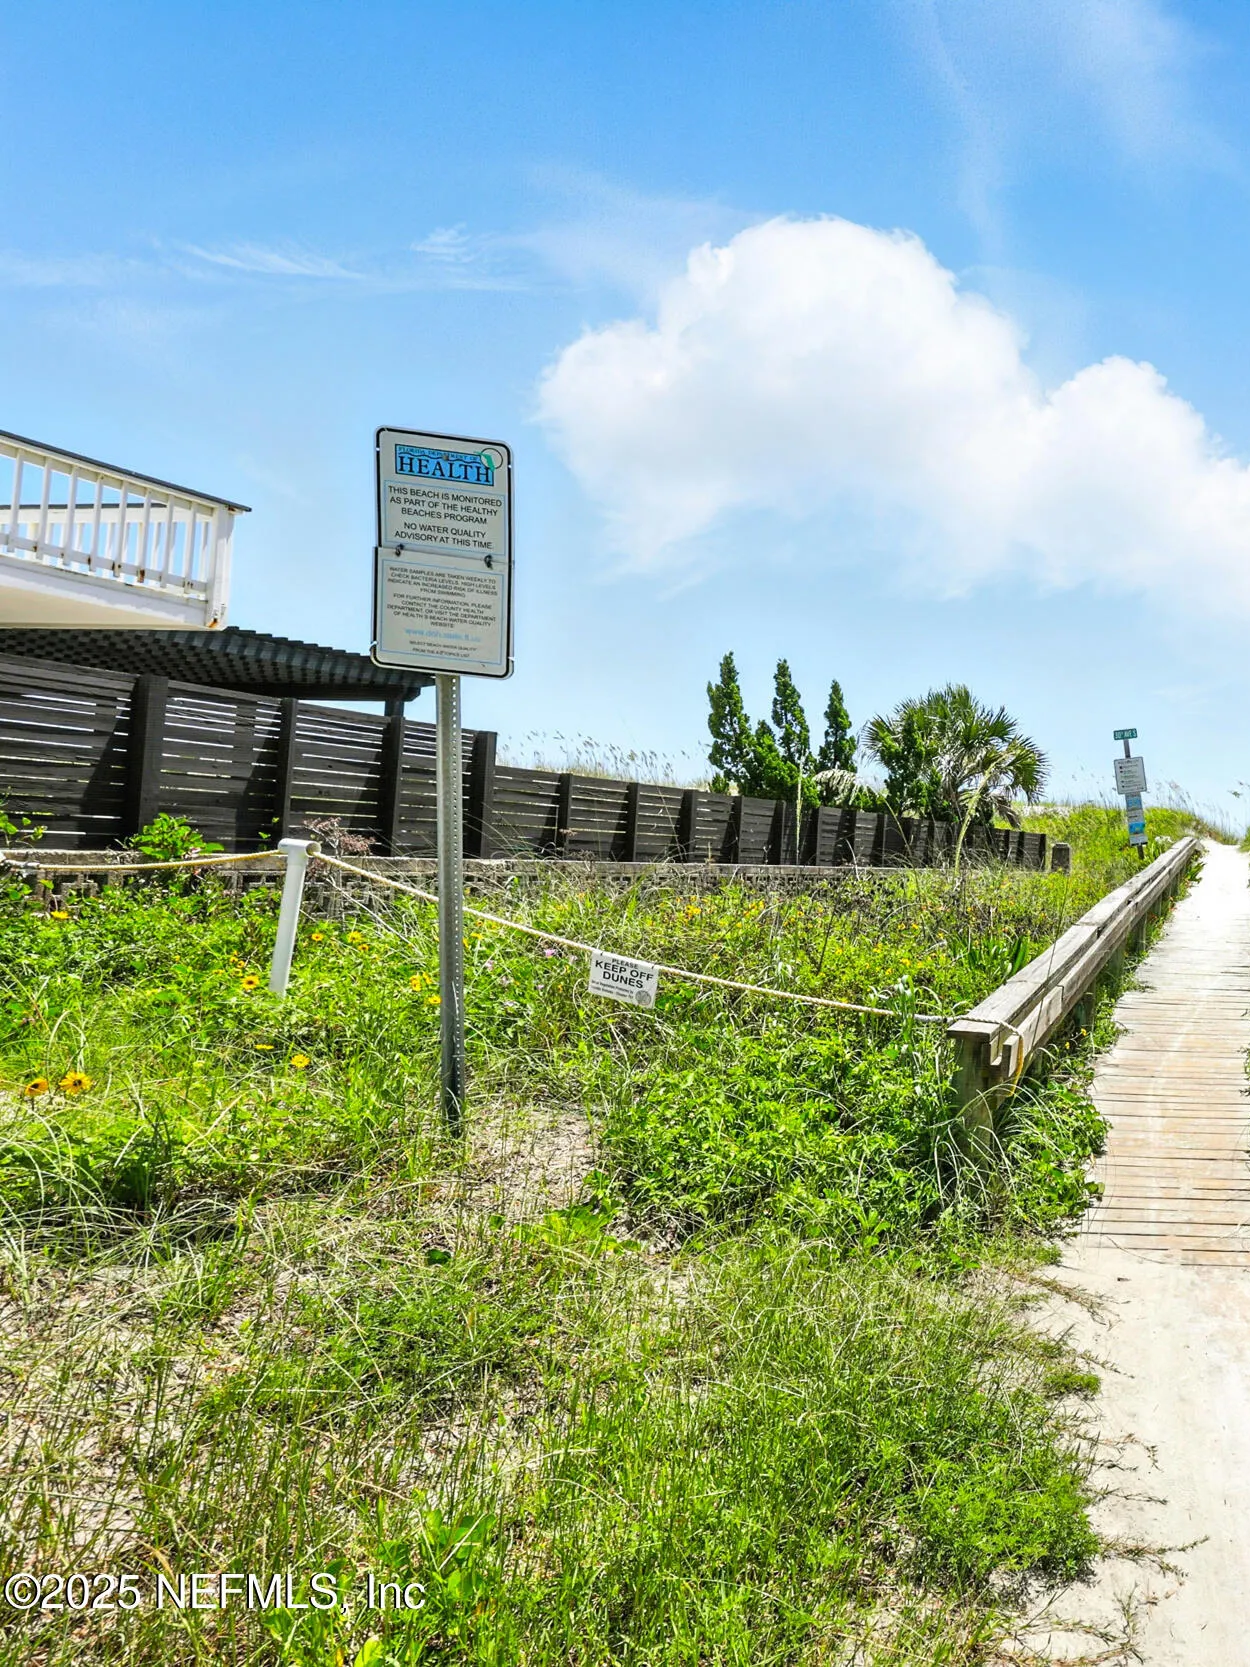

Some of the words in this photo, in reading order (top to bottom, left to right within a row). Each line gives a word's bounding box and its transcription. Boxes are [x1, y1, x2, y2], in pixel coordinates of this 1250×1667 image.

[399, 456, 490, 483] HEALTH
[388, 486, 408, 495] THIS
[410, 488, 439, 499] BEACH
[441, 492, 450, 500] IS
[452, 494, 502, 507] MONITORED
[390, 496, 401, 504] AS
[404, 498, 426, 507] PART
[428, 501, 440, 509] OF
[442, 502, 458, 512] THE
[461, 505, 498, 516] HEALTHY
[401, 507, 441, 519] BEACHES
[444, 512, 487, 524] PROGRAM
[395, 530, 438, 543] ADVISORY
[439, 536, 450, 544] AT
[452, 538, 470, 547] THIS
[404, 522, 417, 530] NO
[419, 524, 448, 534] WATER
[451, 528, 486, 538] QUALITY
[409, 568, 434, 576] SAMPLES
[595, 960, 626, 974] KEEP
[630, 970, 654, 981] OFF
[612, 958, 639, 969] PLEASE
[603, 971, 644, 989] DUNES
